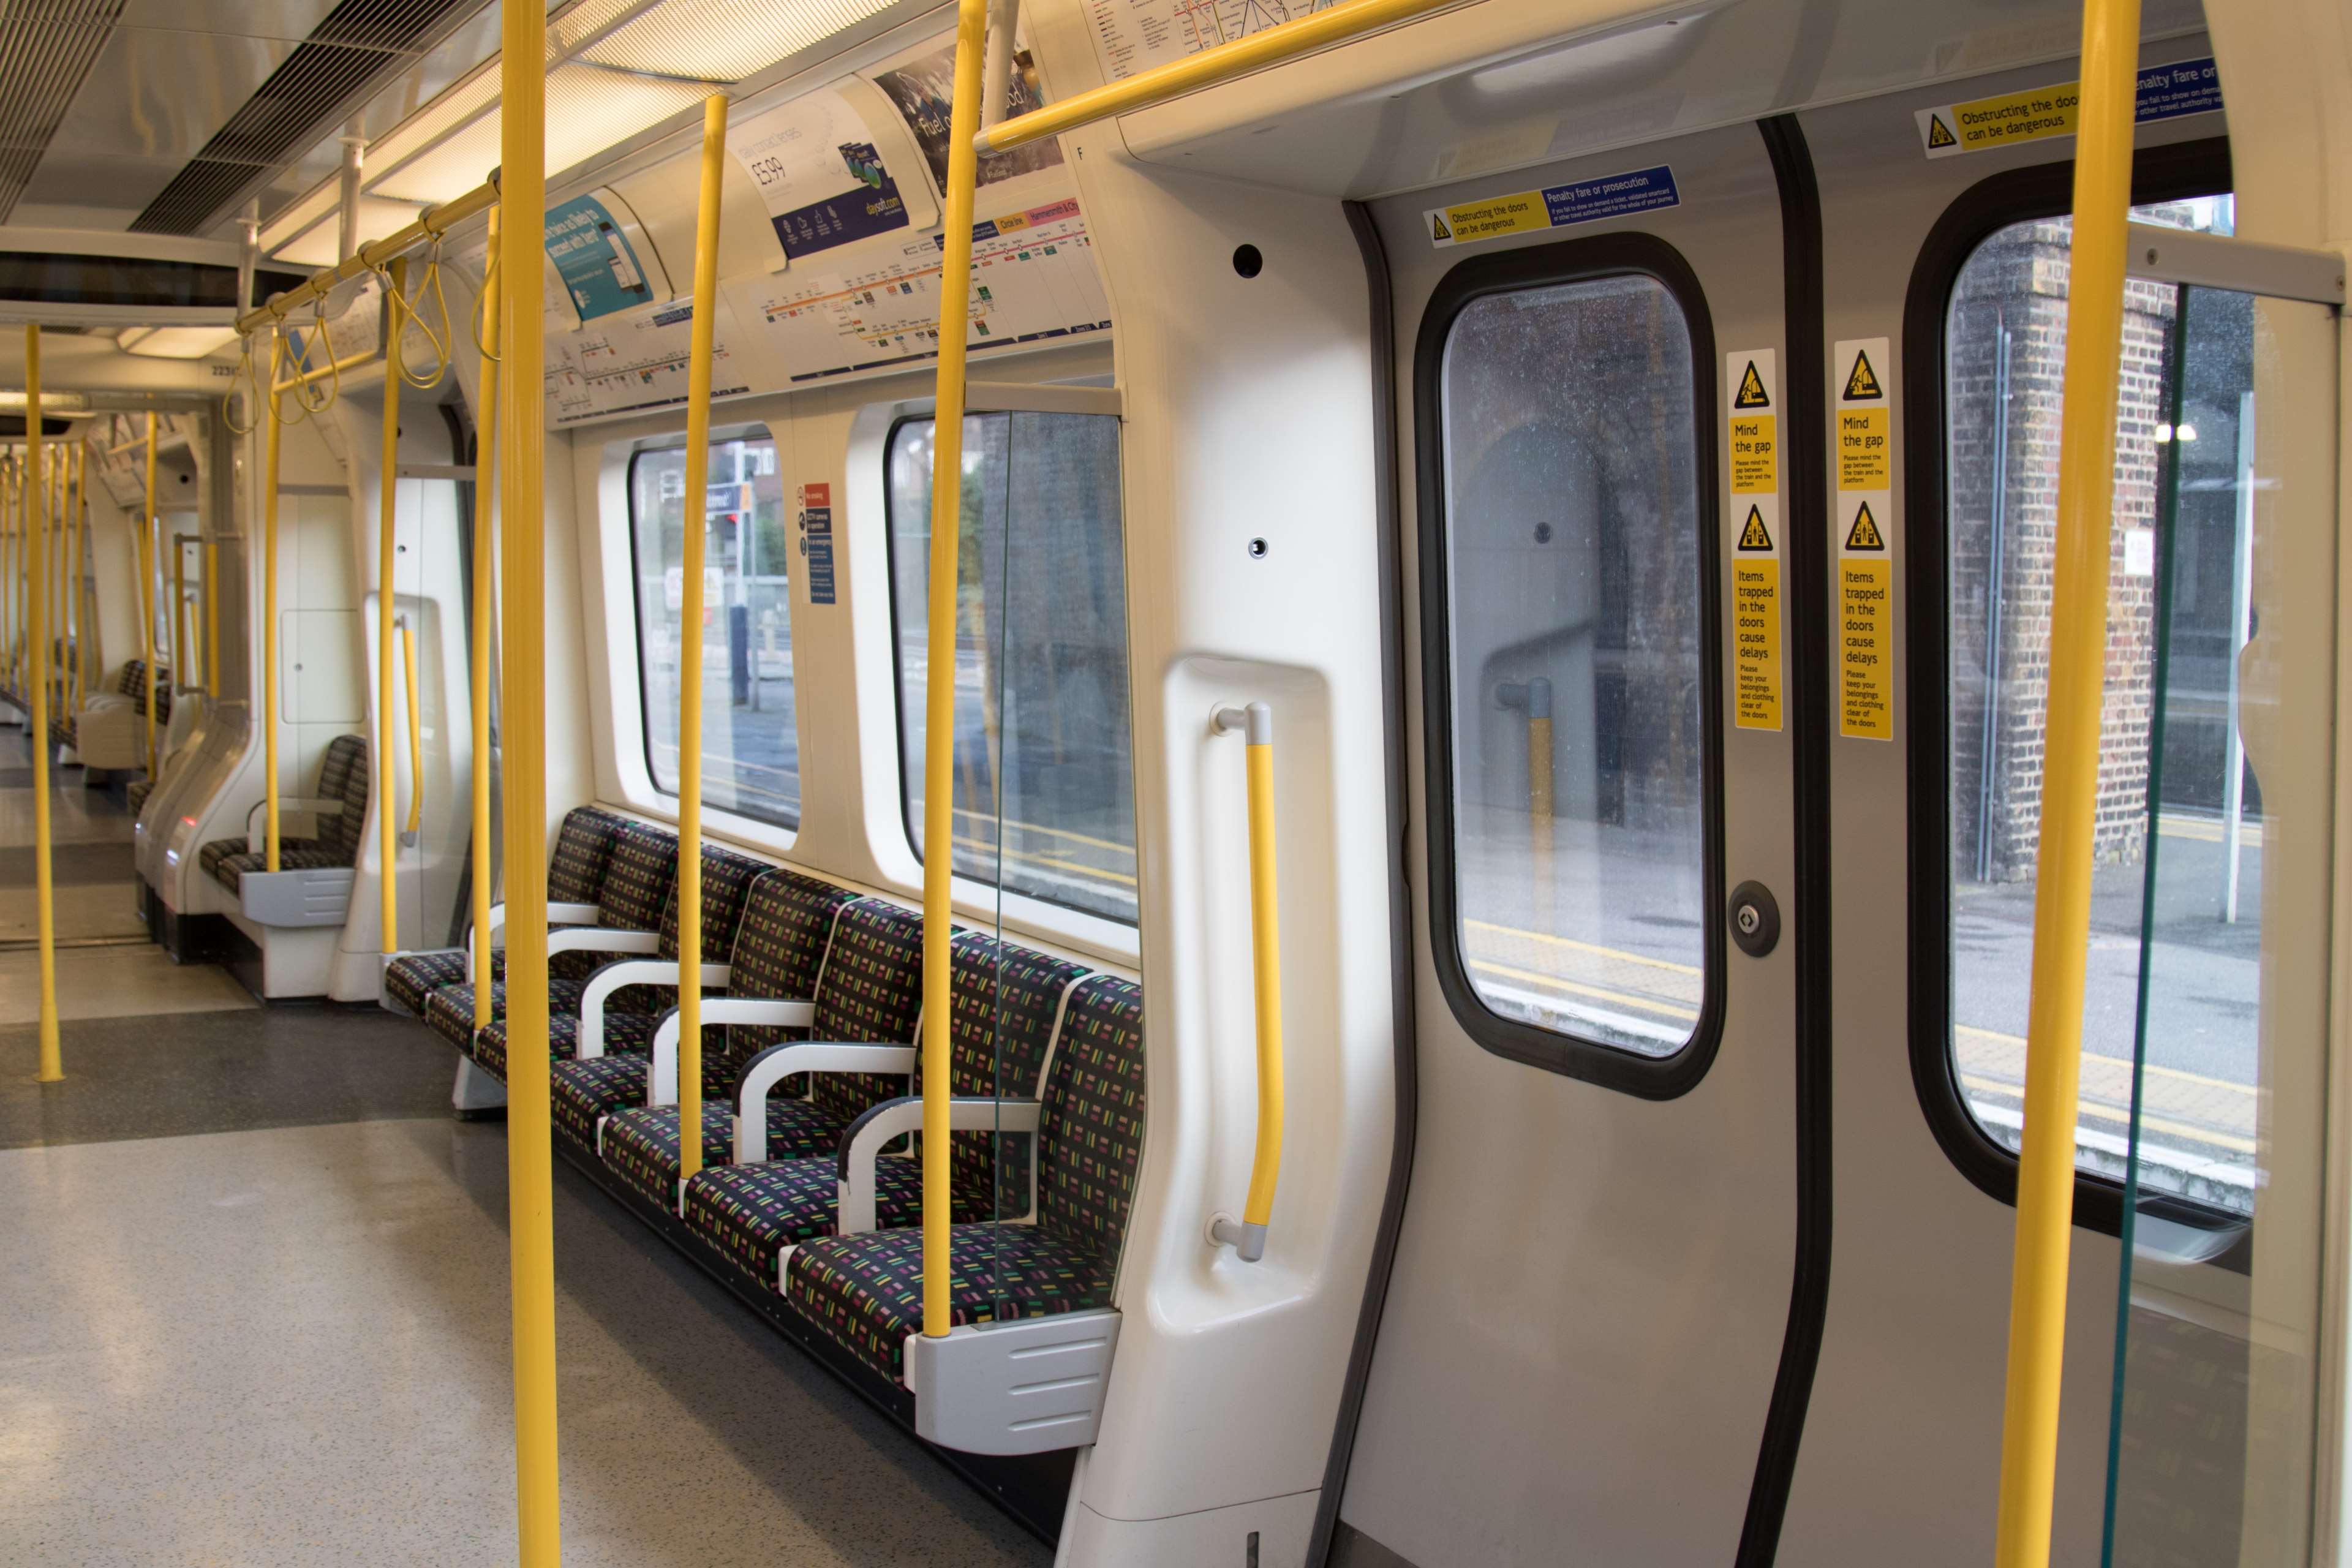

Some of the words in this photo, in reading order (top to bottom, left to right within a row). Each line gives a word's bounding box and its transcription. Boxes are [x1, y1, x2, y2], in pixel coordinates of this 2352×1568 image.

[2173, 70, 2199, 83] fare
[2203, 67, 2215, 78] or
[1961, 104, 2029, 124] Obstructing
[2031, 99, 2051, 112] the
[2055, 95, 2080, 108] doo
[2140, 107, 2158, 115] other
[2160, 102, 2180, 111] travel
[2181, 97, 2212, 108] authority
[918, 111, 946, 138] Fuel
[1967, 129, 1986, 141] can
[1989, 124, 2003, 137] be
[2007, 115, 2065, 135] dangerous
[752, 157, 786, 186] £5.99
[1547, 190, 1575, 203] Penalty
[1576, 187, 1591, 197] fare
[1603, 176, 1649, 194] prosecution
[1452, 208, 1492, 224] Obstructing
[1494, 205, 1506, 216] the
[1508, 202, 1529, 213] doors
[1457, 226, 1469, 236] can
[1470, 222, 1479, 233] be
[1480, 218, 1515, 232] dangerous
[1844, 417, 1869, 429] Mind
[1735, 424, 1758, 436] Mind
[1735, 441, 1752, 453] the
[1755, 440, 1771, 454] gap
[1844, 434, 1861, 447] the
[1865, 435, 1883, 448] gap
[1739, 571, 1764, 582] Items
[1846, 571, 1874, 583] Items
[1739, 587, 1774, 599] trapped
[1846, 588, 1884, 601] trapped
[1739, 601, 1747, 612] in
[1750, 601, 1765, 612] the
[1846, 603, 1855, 614] in
[1858, 603, 1875, 616] the
[1740, 616, 1765, 628] doors
[1846, 619, 1874, 631] doors
[1740, 633, 1765, 643] cause
[1846, 637, 1874, 647] cause
[1740, 647, 1768, 661] delays
[1846, 651, 1878, 666] delays
[1740, 664, 1758, 673] Please
[1846, 670, 1866, 679] Please
[1740, 674, 1754, 682] keep
[1740, 683, 1770, 692] belongings
[1846, 680, 1861, 689] keep
[1752, 693, 1774, 703] clothing
[1846, 690, 1879, 699] belongings
[1859, 699, 1884, 710] clothing
[1859, 719, 1876, 728] doors
